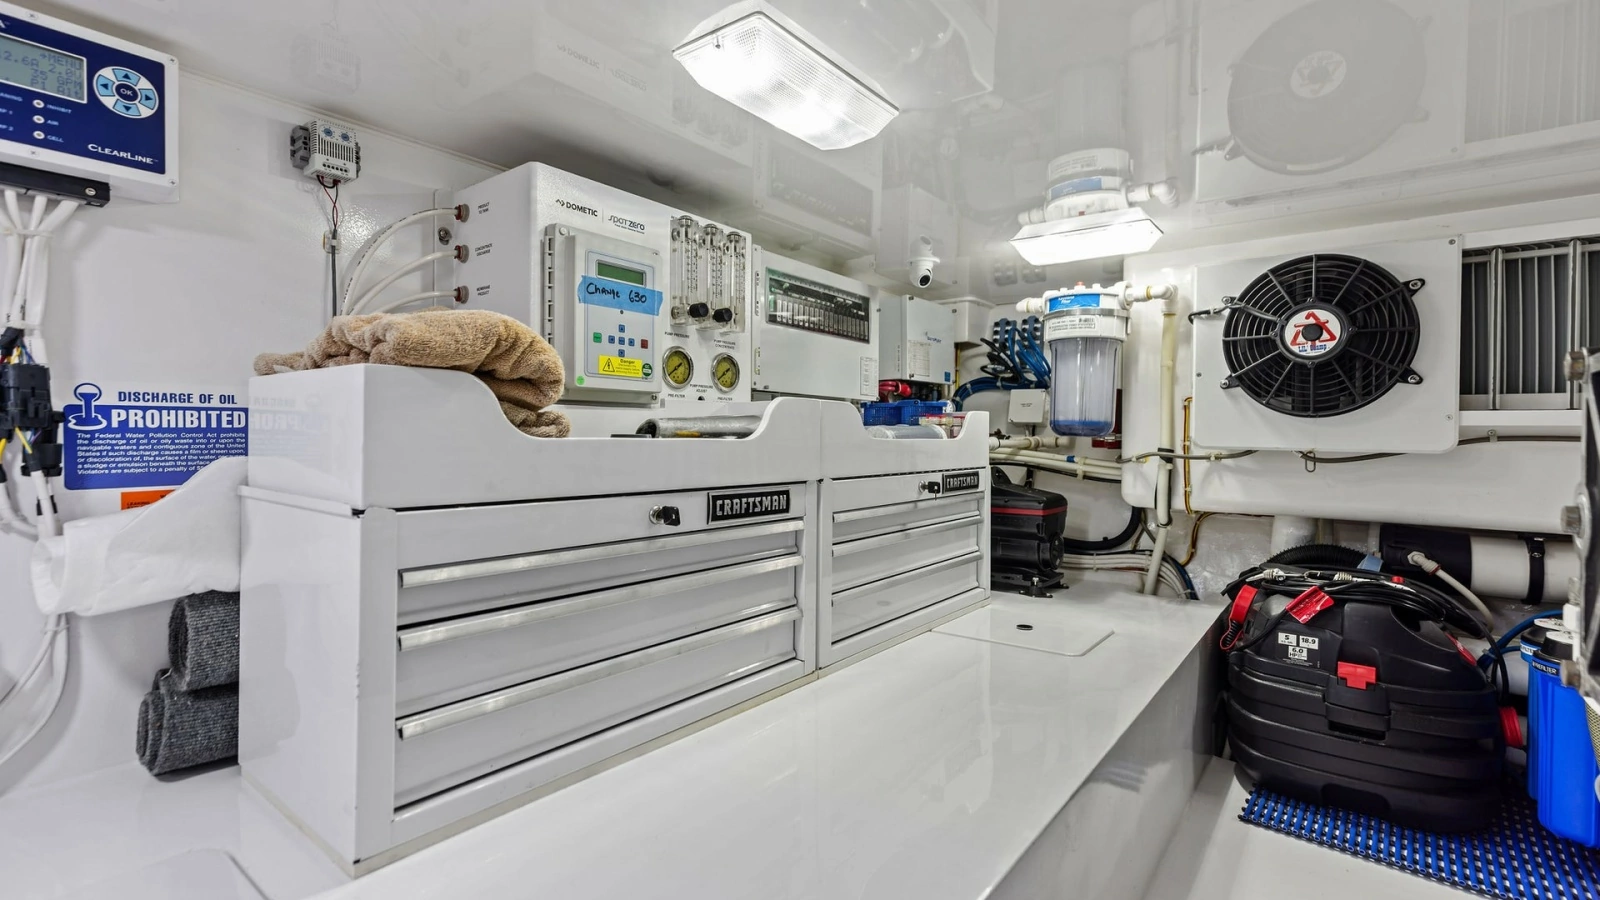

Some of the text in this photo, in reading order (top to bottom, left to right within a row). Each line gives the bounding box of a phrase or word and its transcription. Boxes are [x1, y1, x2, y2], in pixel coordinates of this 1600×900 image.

[0, 50, 40, 67] 2.6A
[120, 88, 133, 96] OK
[566, 202, 598, 216] DOMETIC
[628, 290, 647, 304] 630
[118, 391, 193, 403] DISCHARGE
[199, 394, 214, 404] OF
[219, 394, 237, 404] OIL
[111, 409, 246, 428] PROHIBITED
[946, 472, 979, 490] CRAFTSMAN
[716, 494, 787, 517] CRAFTSMAN
